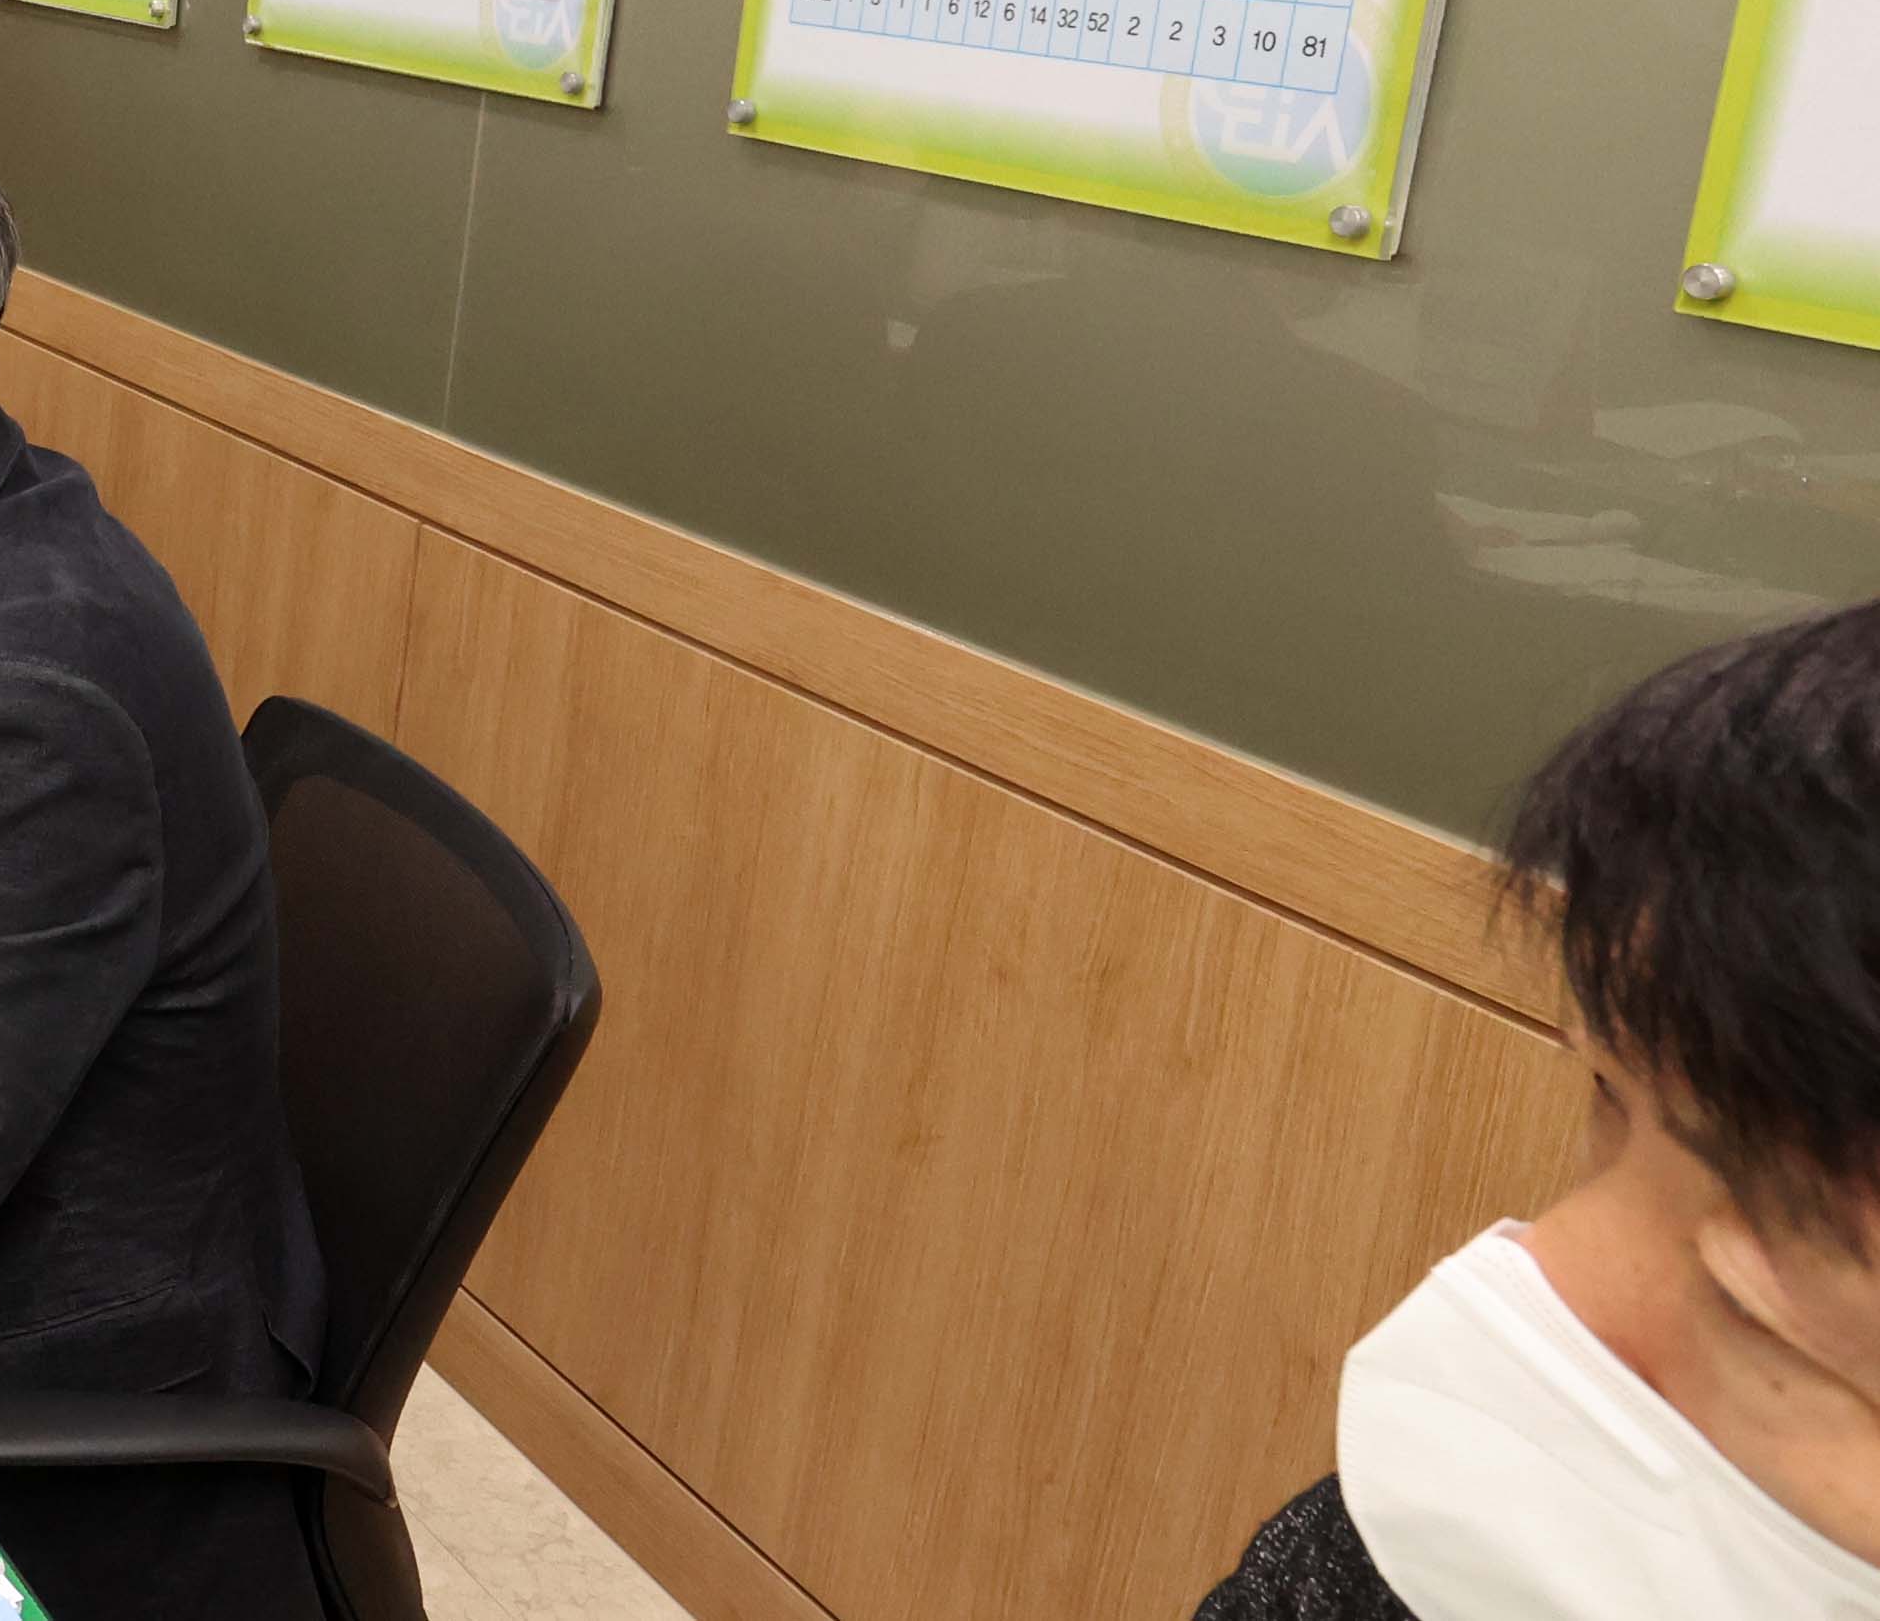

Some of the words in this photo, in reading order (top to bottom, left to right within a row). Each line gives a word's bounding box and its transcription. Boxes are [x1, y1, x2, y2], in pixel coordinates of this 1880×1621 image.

[973, 0, 991, 20] 12
[1003, 2, 1016, 23] 6
[1030, 5, 1048, 26] 14
[1057, 8, 1079, 30] 32
[1087, 11, 1109, 33] 52
[1127, 16, 1141, 36] 2
[1169, 21, 1184, 41] 2
[1212, 26, 1226, 46] 3
[1253, 30, 1277, 52] 10
[1302, 35, 1327, 58] 81
